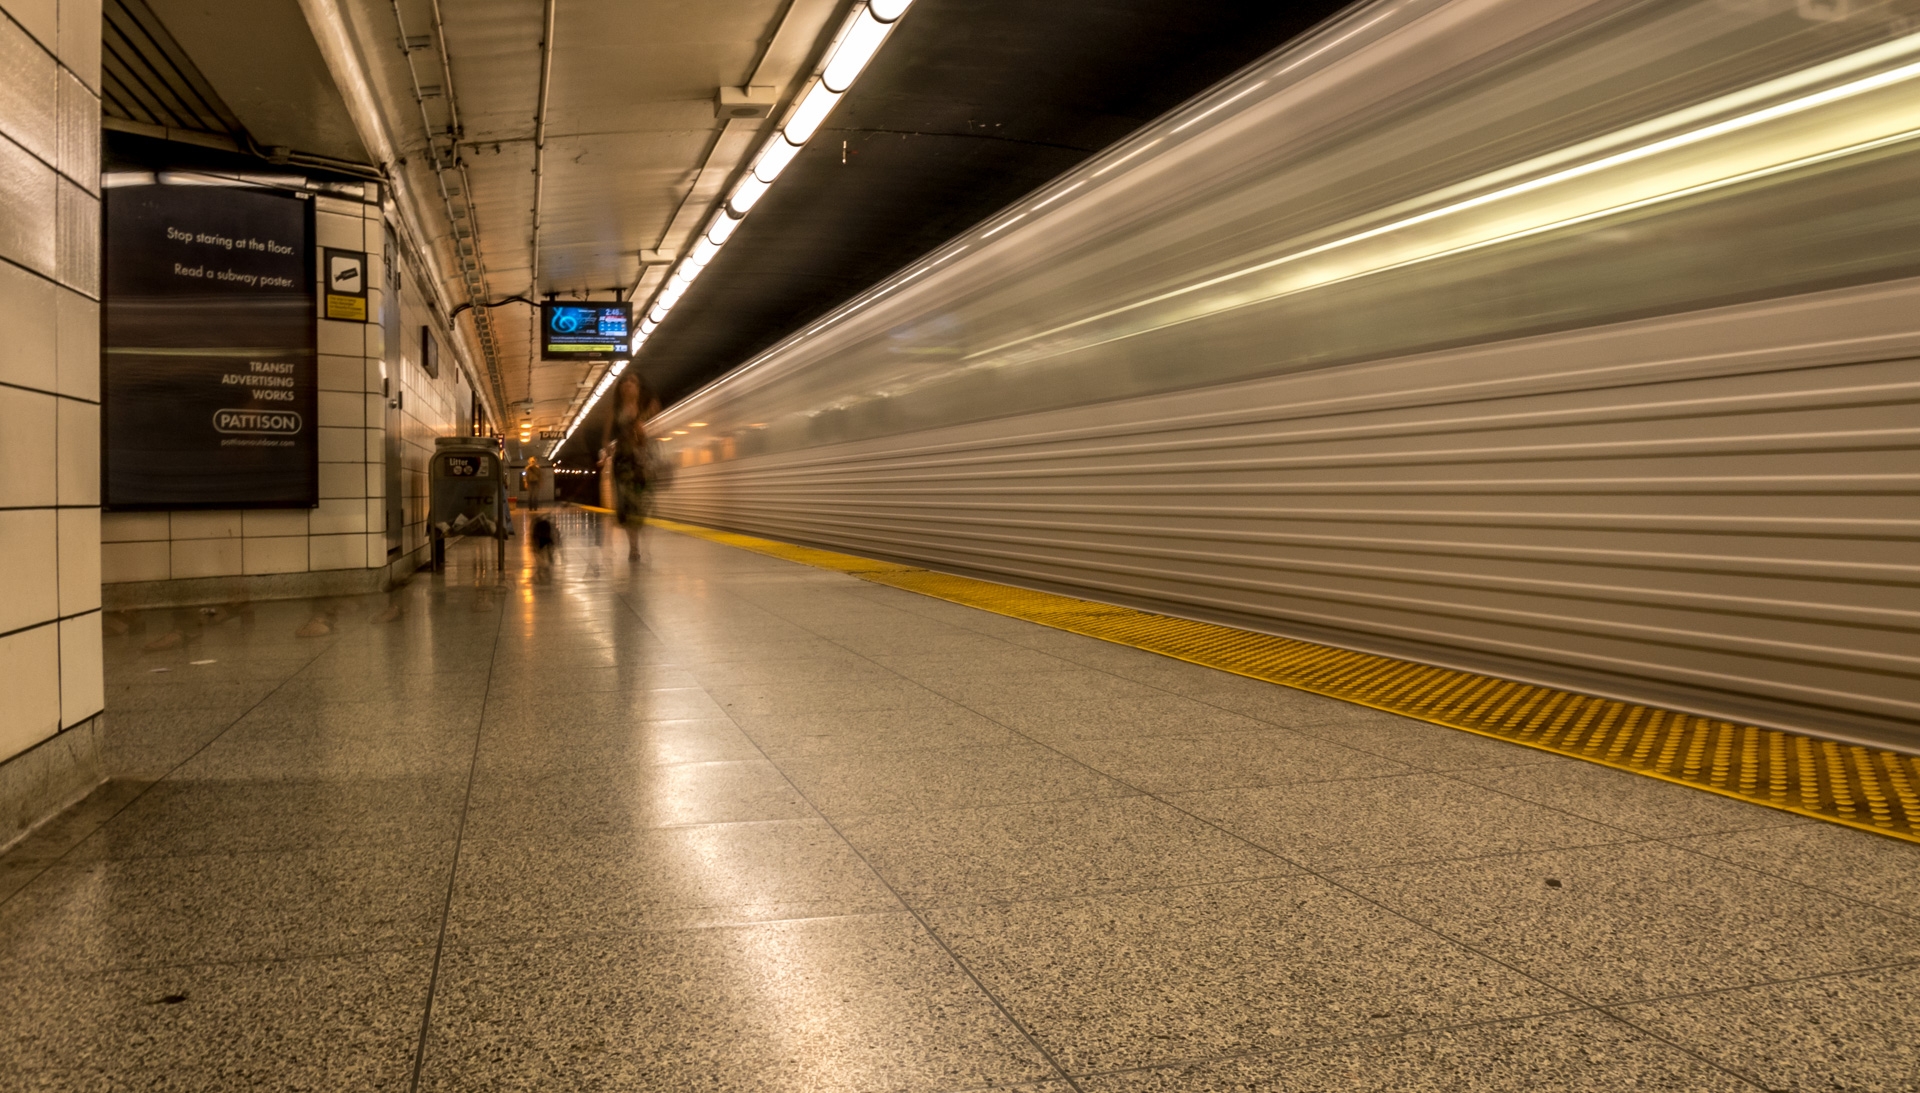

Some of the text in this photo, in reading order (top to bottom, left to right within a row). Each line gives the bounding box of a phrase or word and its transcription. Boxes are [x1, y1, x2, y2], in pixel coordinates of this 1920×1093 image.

[167, 226, 295, 255] Stop staring at the floor.
[174, 263, 295, 288] Read a subway poster.
[249, 361, 294, 373] TRANSIT
[221, 374, 294, 387] ADVERTISING
[252, 389, 294, 400] WORKS
[220, 414, 295, 430] PATTISON
[449, 457, 469, 466] Litter
[464, 496, 494, 505] TTC
